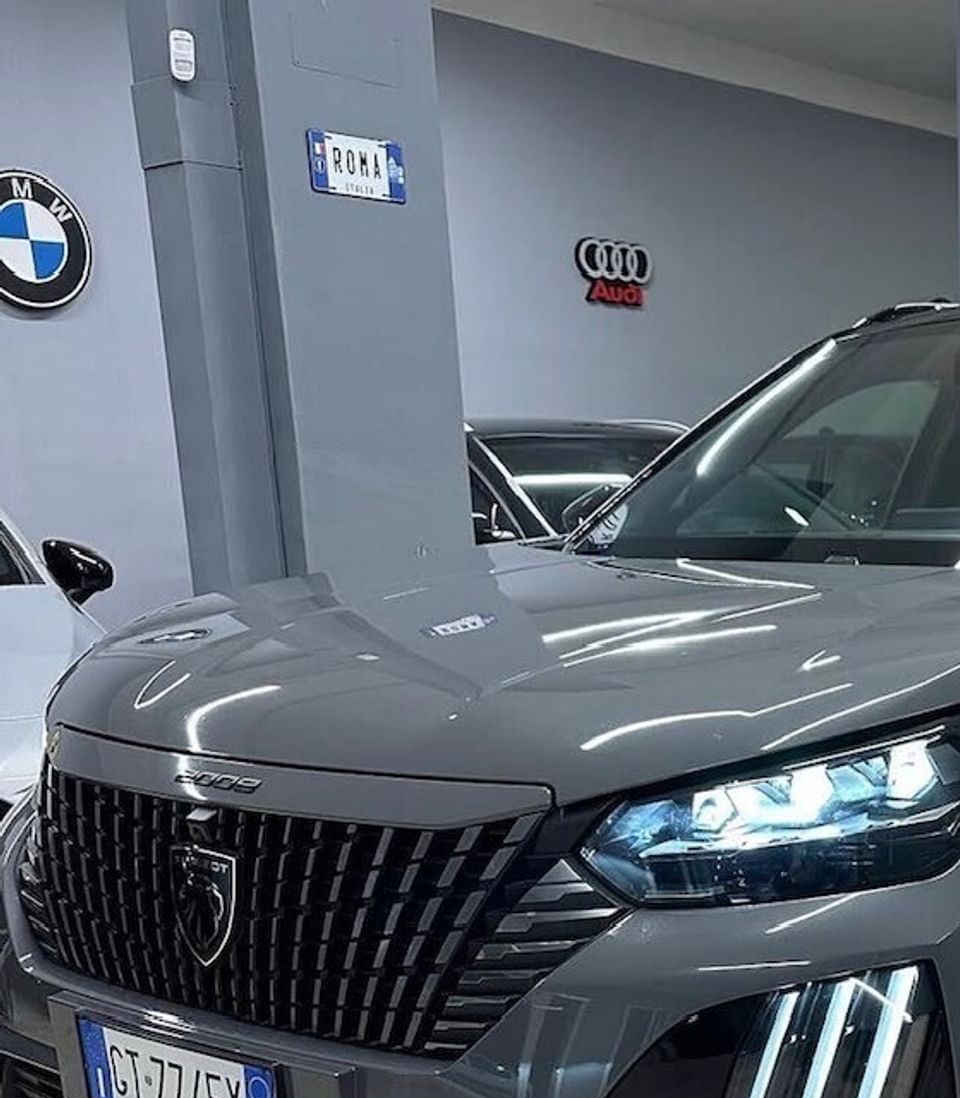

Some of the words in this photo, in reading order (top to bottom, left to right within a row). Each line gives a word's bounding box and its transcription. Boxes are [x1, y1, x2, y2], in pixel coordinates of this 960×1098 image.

[333, 147, 382, 180] ROMA
[590, 279, 649, 305] Audi
[175, 769, 263, 795] 2008
